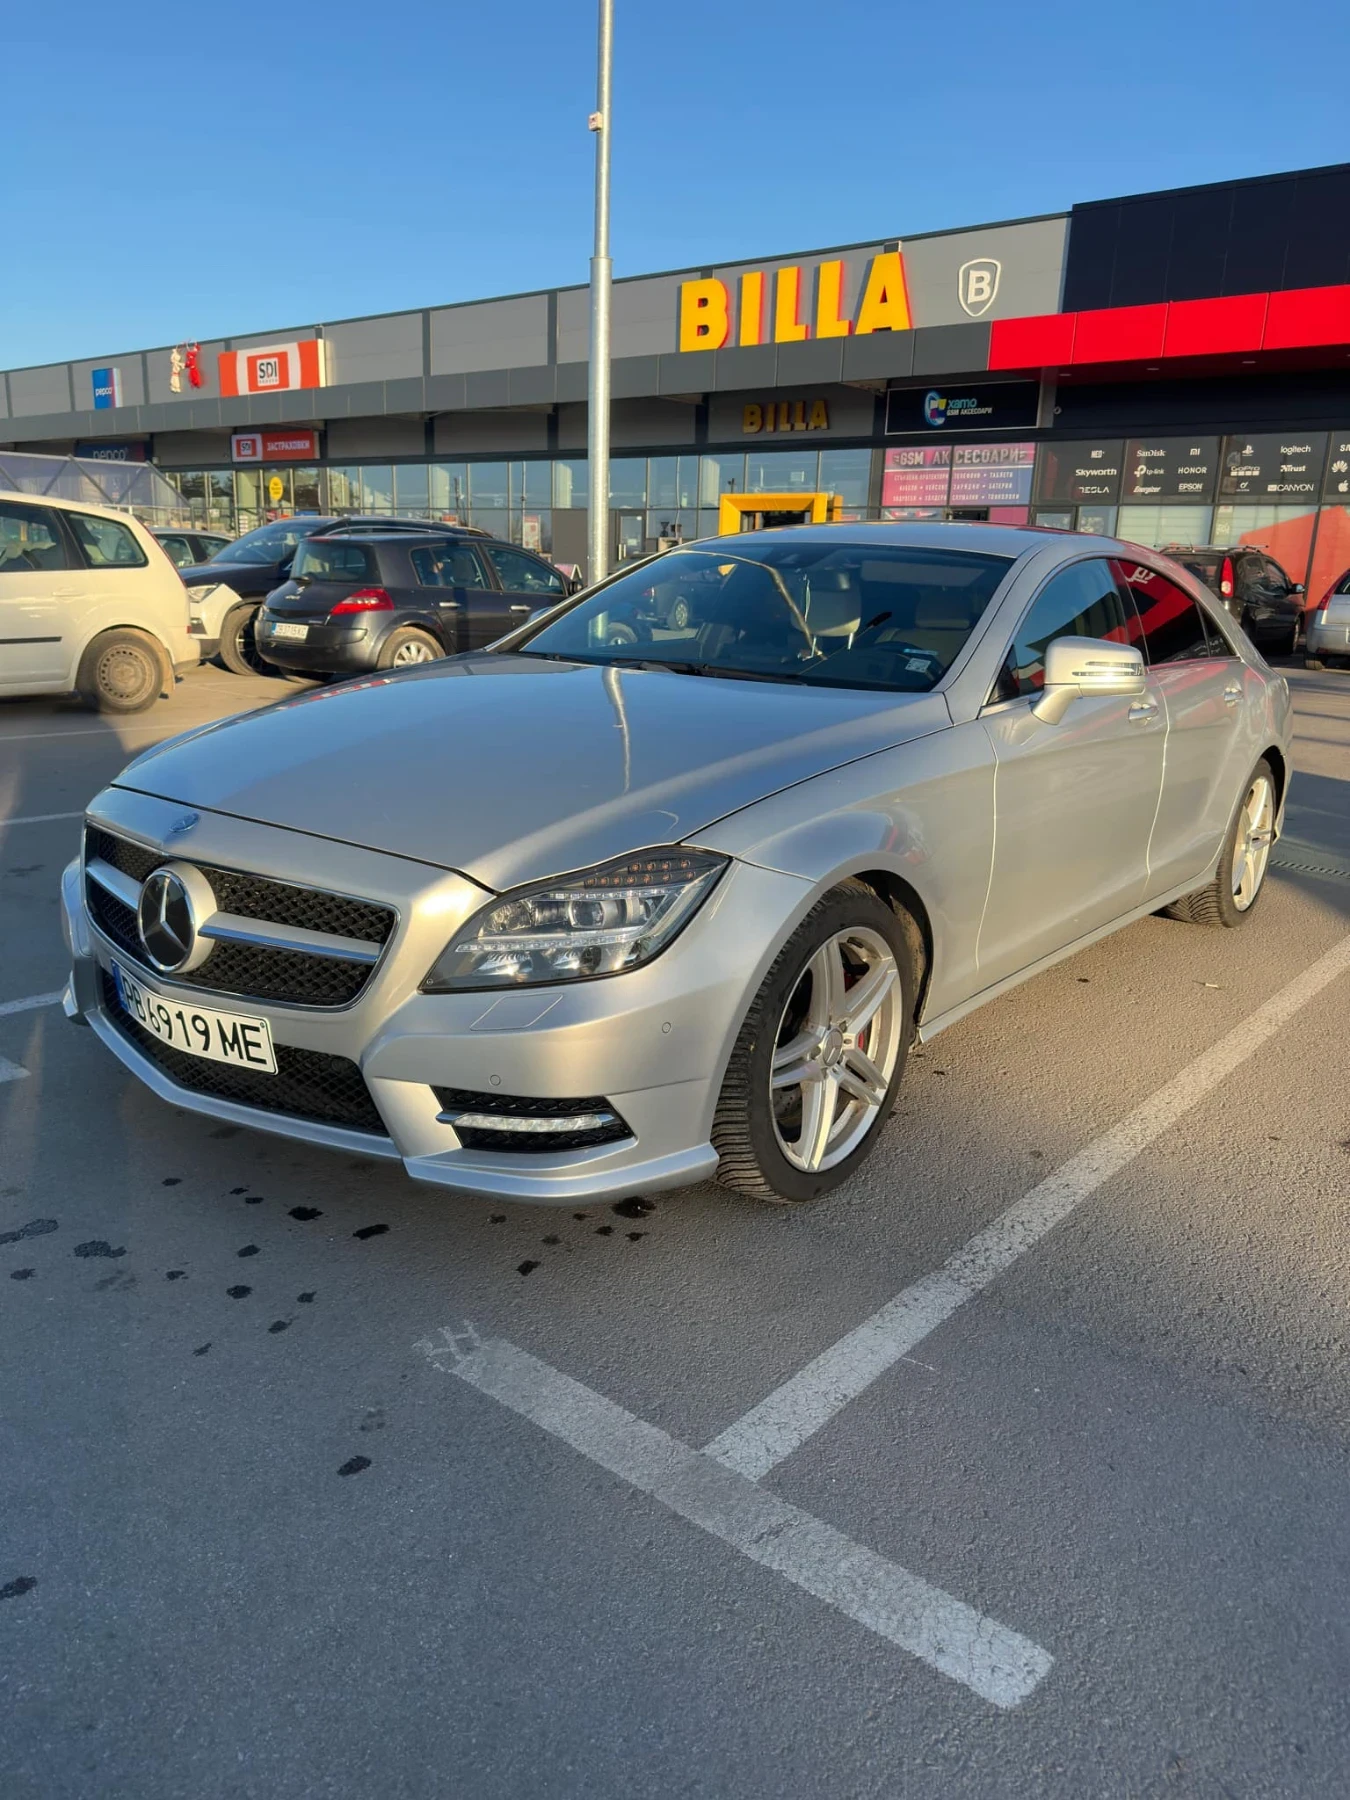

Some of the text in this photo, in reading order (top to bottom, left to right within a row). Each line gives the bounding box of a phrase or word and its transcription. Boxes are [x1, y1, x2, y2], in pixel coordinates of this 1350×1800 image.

[680, 251, 913, 352] BILLA
[258, 361, 278, 379] SDI
[95, 387, 113, 397] pepco
[743, 399, 830, 433] BILLA
[241, 442, 251, 451] SDI
[267, 440, 310, 451] ЗАСТРАХОВКИ
[1280, 445, 1311, 455] logitech
[900, 452, 924, 465] GSM
[1136, 449, 1166, 457] SanDisk
[1075, 468, 1117, 478] Skyworth
[147, 998, 211, 1051] 6919
[217, 1018, 267, 1065] ME
